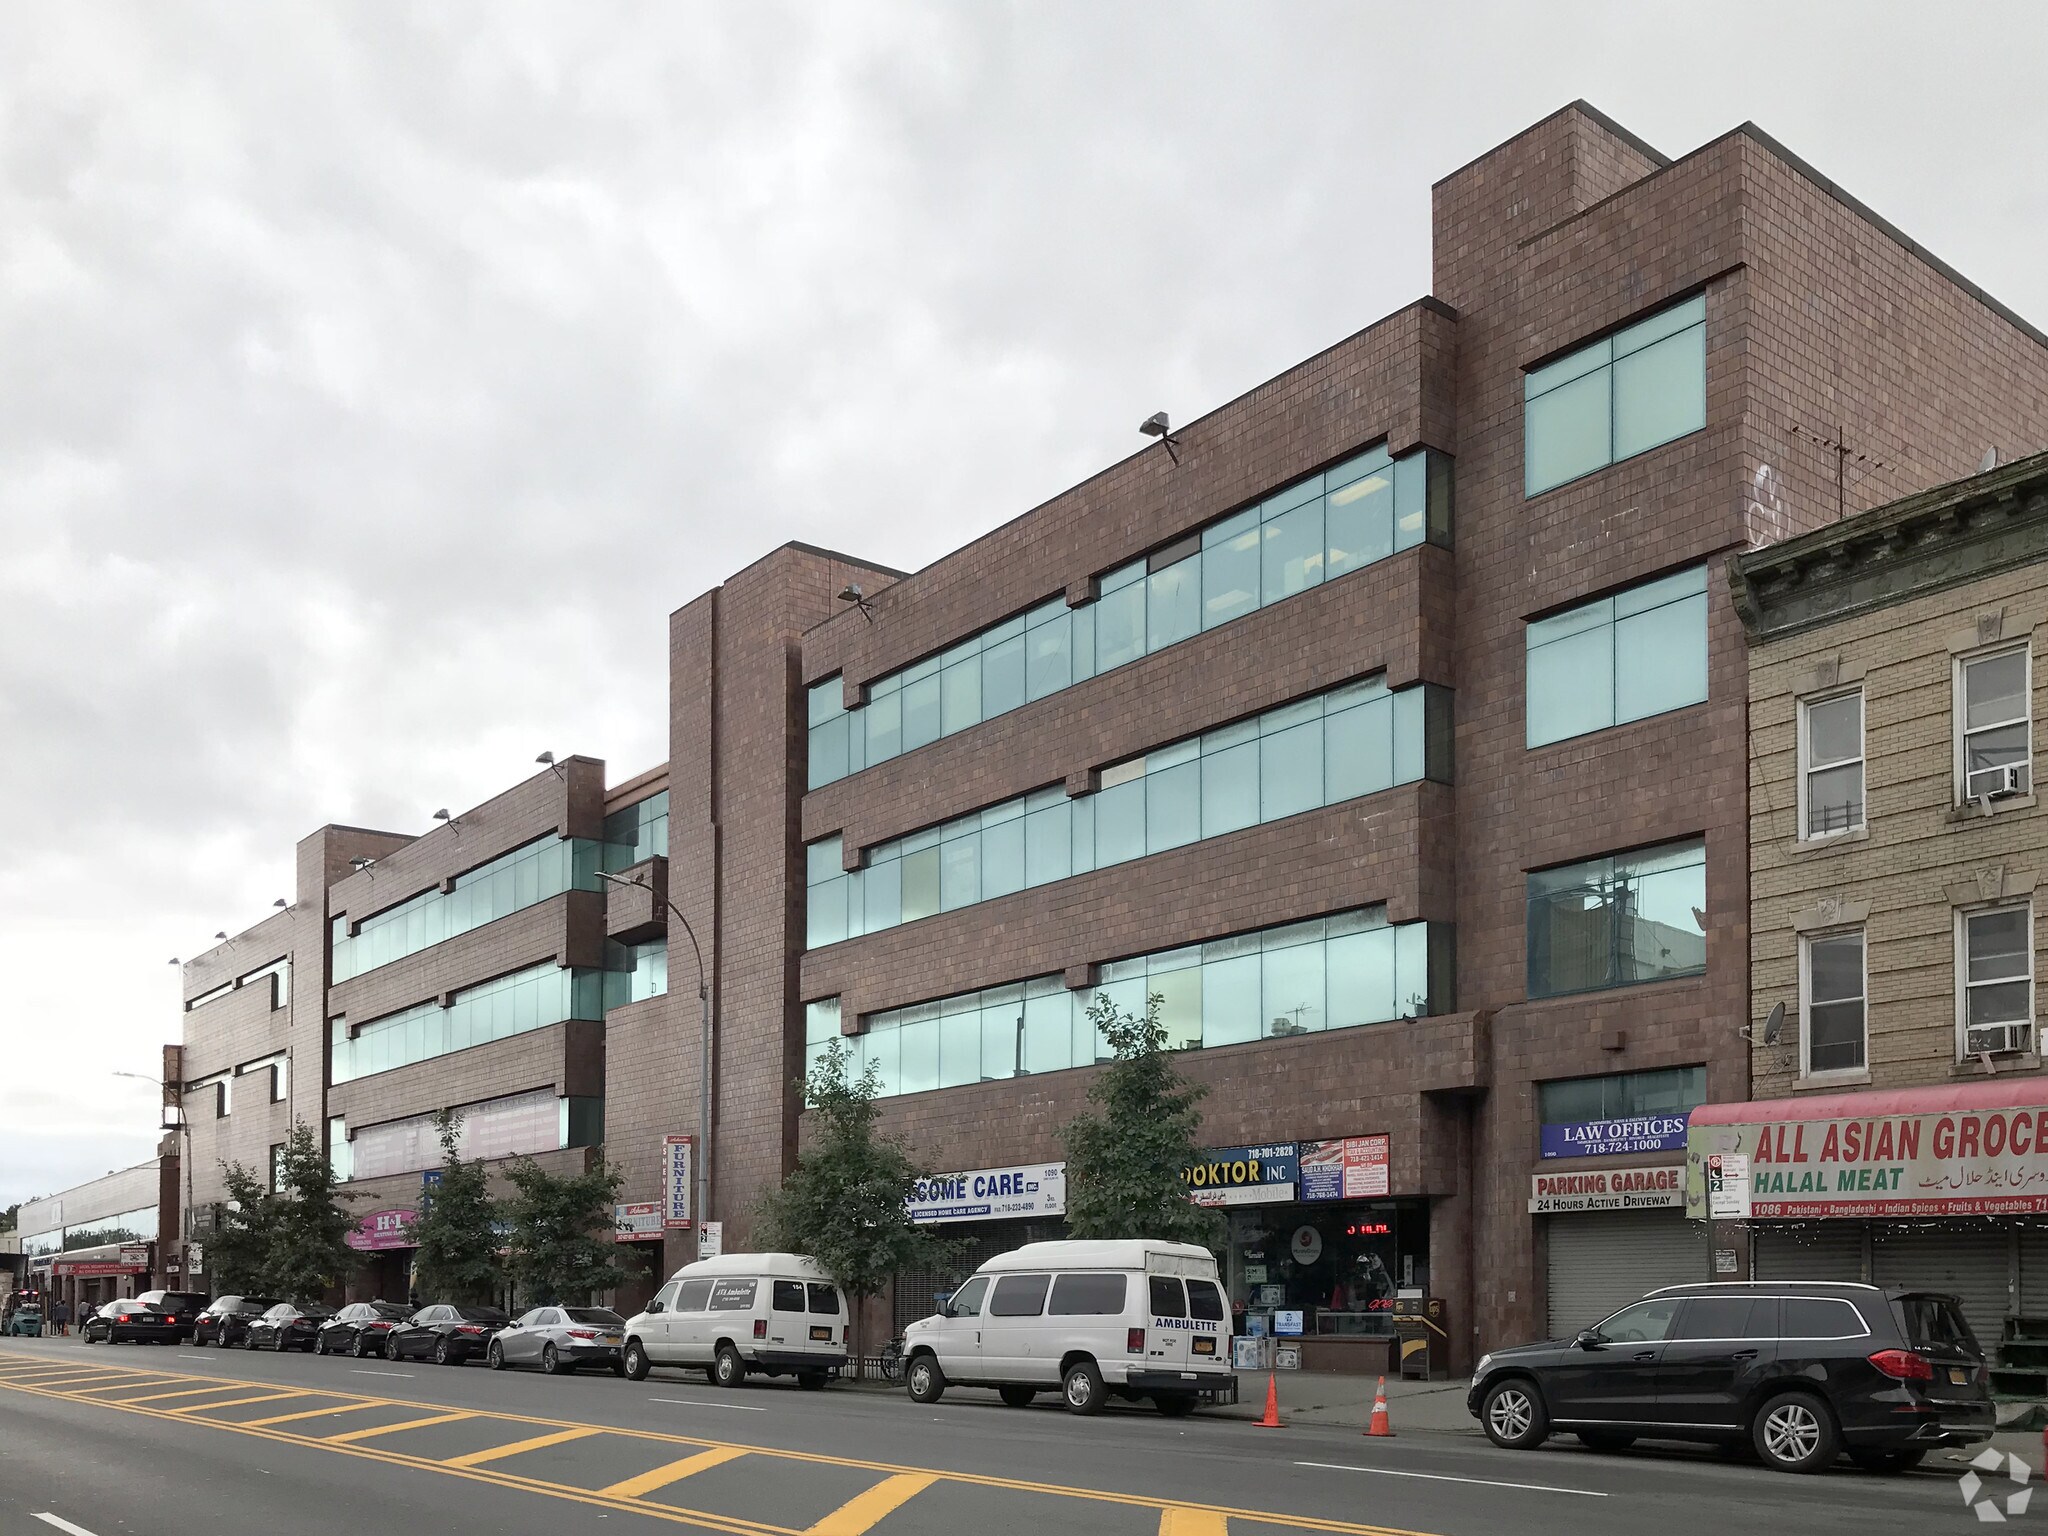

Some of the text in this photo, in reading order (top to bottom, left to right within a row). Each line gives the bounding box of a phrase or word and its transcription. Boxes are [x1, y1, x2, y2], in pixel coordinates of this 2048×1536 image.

[1564, 1118, 1684, 1142] LAW OFFICES
[1585, 1139, 1661, 1154] 718-724-1000
[1754, 1125, 1808, 1163] ALL
[1820, 1120, 1921, 1162] ASIAN
[1248, 1146, 1294, 1159] 718-701-2828
[673, 1144, 685, 1218] FURNITURE
[1266, 1166, 1286, 1181] INC
[1754, 1168, 1904, 1193] HALAL MEAT
[908, 1178, 967, 1203] COME
[973, 1172, 1024, 1198] CARE
[1538, 1170, 1678, 1196] PARKING GARAGE
[1713, 1180, 1720, 1191] 2
[914, 1210, 938, 1218] LICENSED
[938, 1209, 952, 1217] HOME
[967, 1206, 988, 1214] AGENCY
[1537, 1200, 1550, 1210] 24
[1755, 1204, 1781, 1215] 1086
[1787, 1204, 1821, 1214] Pakistani
[1830, 1203, 1876, 1215] Bangladeshi
[1885, 1203, 1909, 1213] Indian
[1911, 1202, 1939, 1213] Spices
[1948, 1201, 1972, 1211] Fruits
[1975, 1201, 1981, 1210] &
[1985, 1200, 2032, 1211] Vegetables
[1155, 1318, 1217, 1332] AMBULETTE
